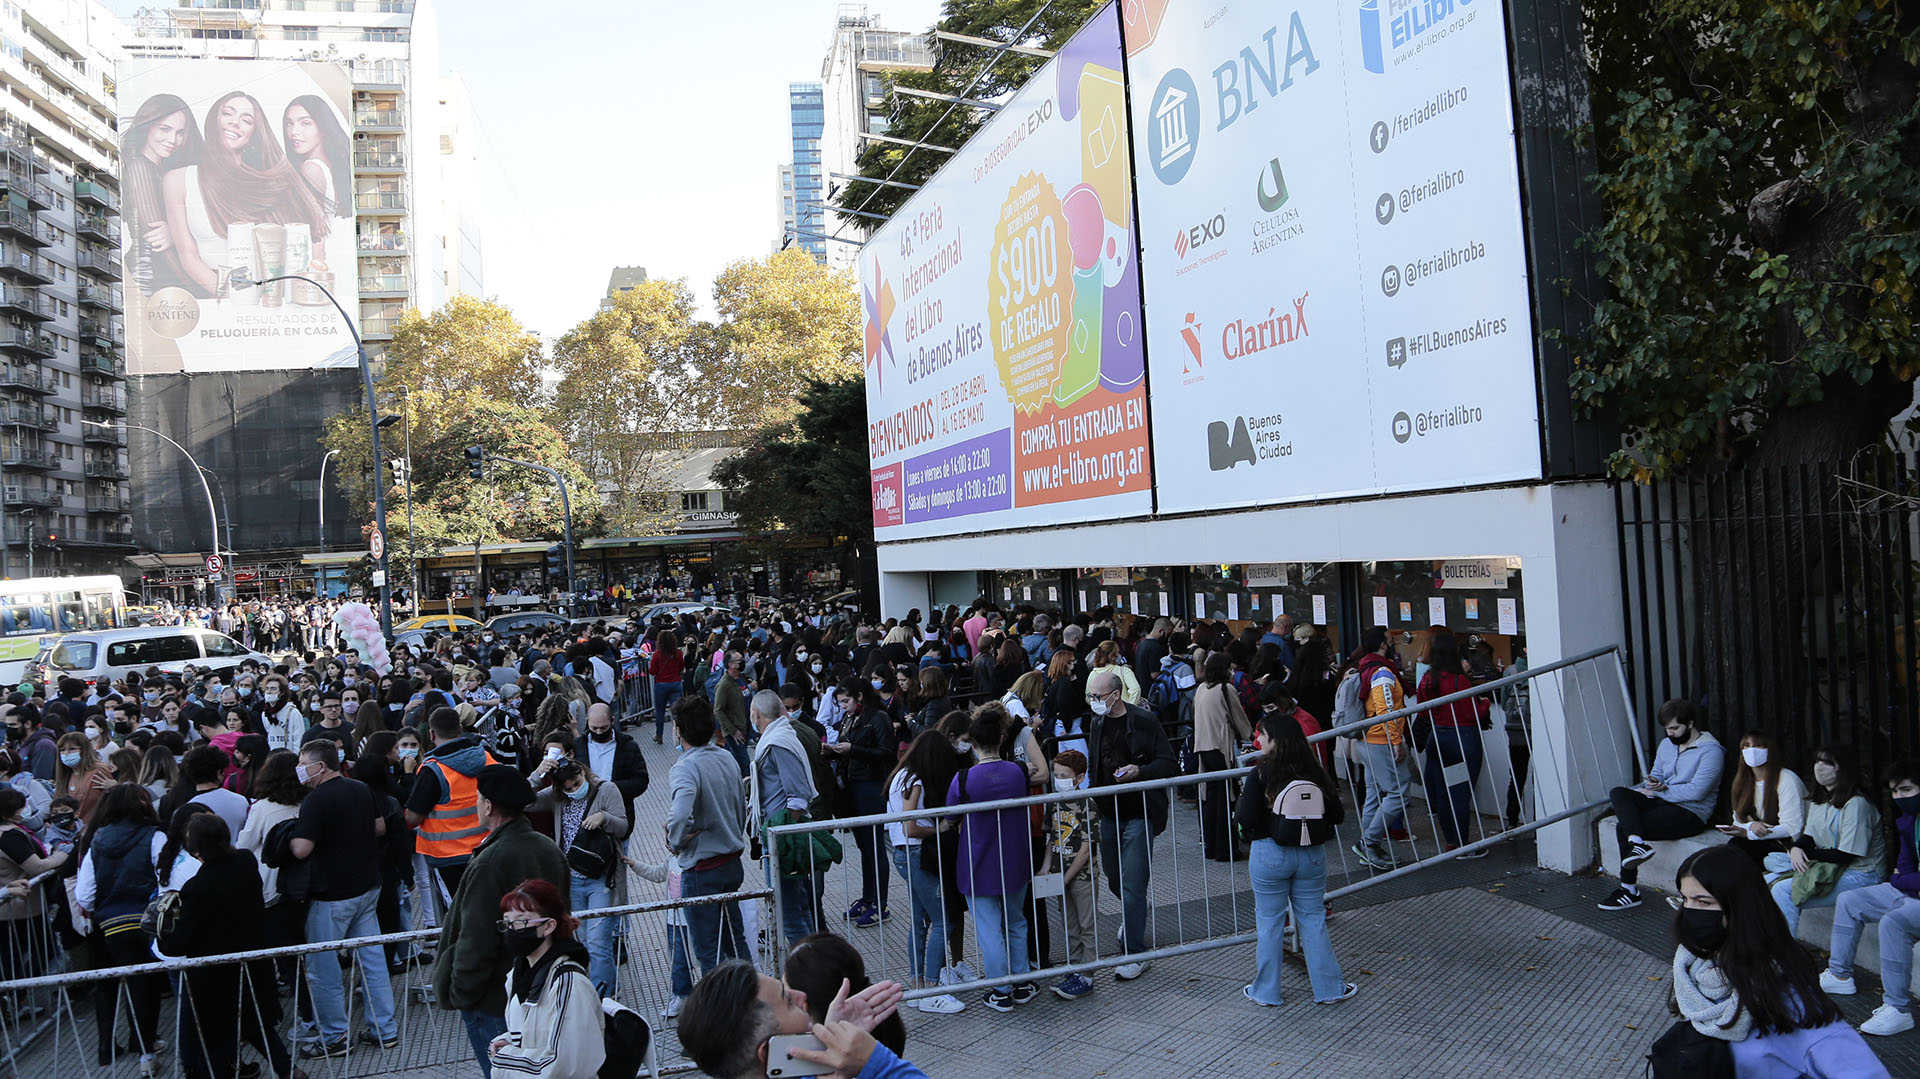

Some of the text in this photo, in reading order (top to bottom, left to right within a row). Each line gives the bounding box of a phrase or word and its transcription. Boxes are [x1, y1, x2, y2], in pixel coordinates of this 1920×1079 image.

[1393, 8, 1478, 66] www.el-libro.org.ar
[1212, 9, 1320, 133] BNA
[1391, 85, 1468, 139] /feriadellibro
[973, 98, 1052, 184] Con BIOSEGURIDAD EXO
[1399, 169, 1465, 213] @ferialibro
[919, 201, 943, 245] Feria
[1189, 213, 1226, 249] EXO
[902, 226, 962, 302] Internacional
[998, 215, 1058, 316] $900
[1405, 241, 1485, 287] @ferialibroba
[148, 311, 197, 321] PANTENE
[200, 326, 338, 339] PELUQUERÍA EN CASA
[236, 313, 337, 326] RESULTADOS DE
[905, 297, 943, 343] del Libro
[1001, 315, 1014, 352] DE
[1016, 292, 1060, 345] REGALO
[1222, 307, 1294, 360] Clarín
[1409, 317, 1507, 356] #FILBuenosAires
[907, 352, 918, 385] de
[919, 339, 953, 379] Buenos
[955, 322, 983, 361] Aires
[941, 390, 951, 410] DEL
[952, 385, 960, 406] 28
[960, 381, 969, 402] DE
[970, 373, 987, 398] ABRIL
[871, 398, 934, 459] BIENVENIDOS
[943, 401, 984, 435] AL 16 DE MAYO
[1021, 397, 1144, 456] COMPRÁ TU ENTRADA EN
[1249, 414, 1282, 430] Buenos
[1256, 430, 1280, 444] Aires
[1415, 404, 1482, 437] @ferialibro
[907, 470, 920, 487] Lunes
[924, 465, 942, 483] viernes
[943, 459, 950, 478] de
[951, 453, 966, 476] 14:00
[972, 447, 991, 471] 22:00
[1022, 446, 1145, 493] www.el-libro.org.ar
[1259, 441, 1292, 460] Ciudad
[908, 491, 926, 511] Sábados
[931, 487, 955, 510] domingos
[956, 482, 963, 502] de
[964, 479, 981, 501] 13:00
[987, 473, 1007, 497] 22:00
[1445, 561, 1491, 578] BOLETERÍAS
